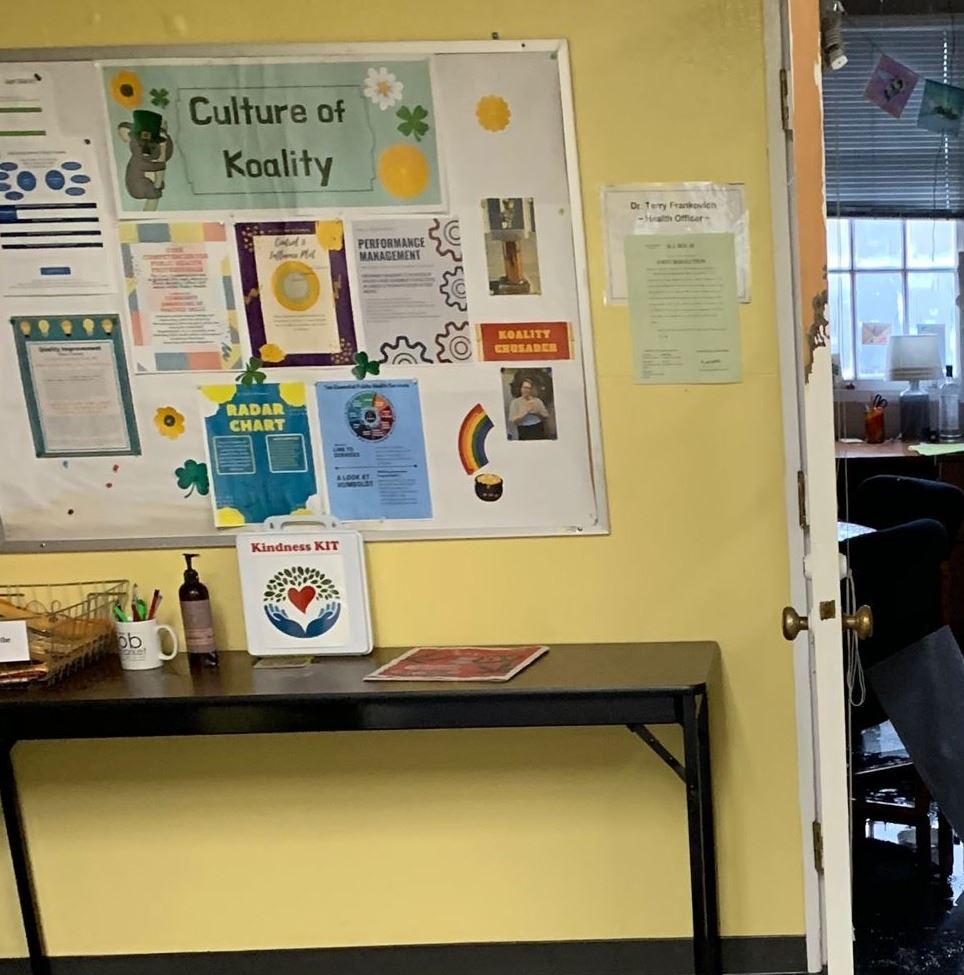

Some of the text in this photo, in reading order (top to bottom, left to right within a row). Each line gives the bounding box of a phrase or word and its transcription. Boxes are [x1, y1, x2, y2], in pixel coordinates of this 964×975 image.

[189, 96, 345, 125] Culture of
[223, 149, 333, 187] Koality
[645, 201, 667, 211] Terry
[669, 201, 717, 209] Frankovich
[357, 237, 426, 249] PERFORMANCE
[359, 250, 421, 261] MANAGEMENT
[498, 329, 551, 340] KOALITY
[494, 343, 558, 353] CRUSADER
[226, 403, 285, 416] RADAR
[229, 419, 286, 432] CHART
[251, 541, 339, 553] Kindness KIT
